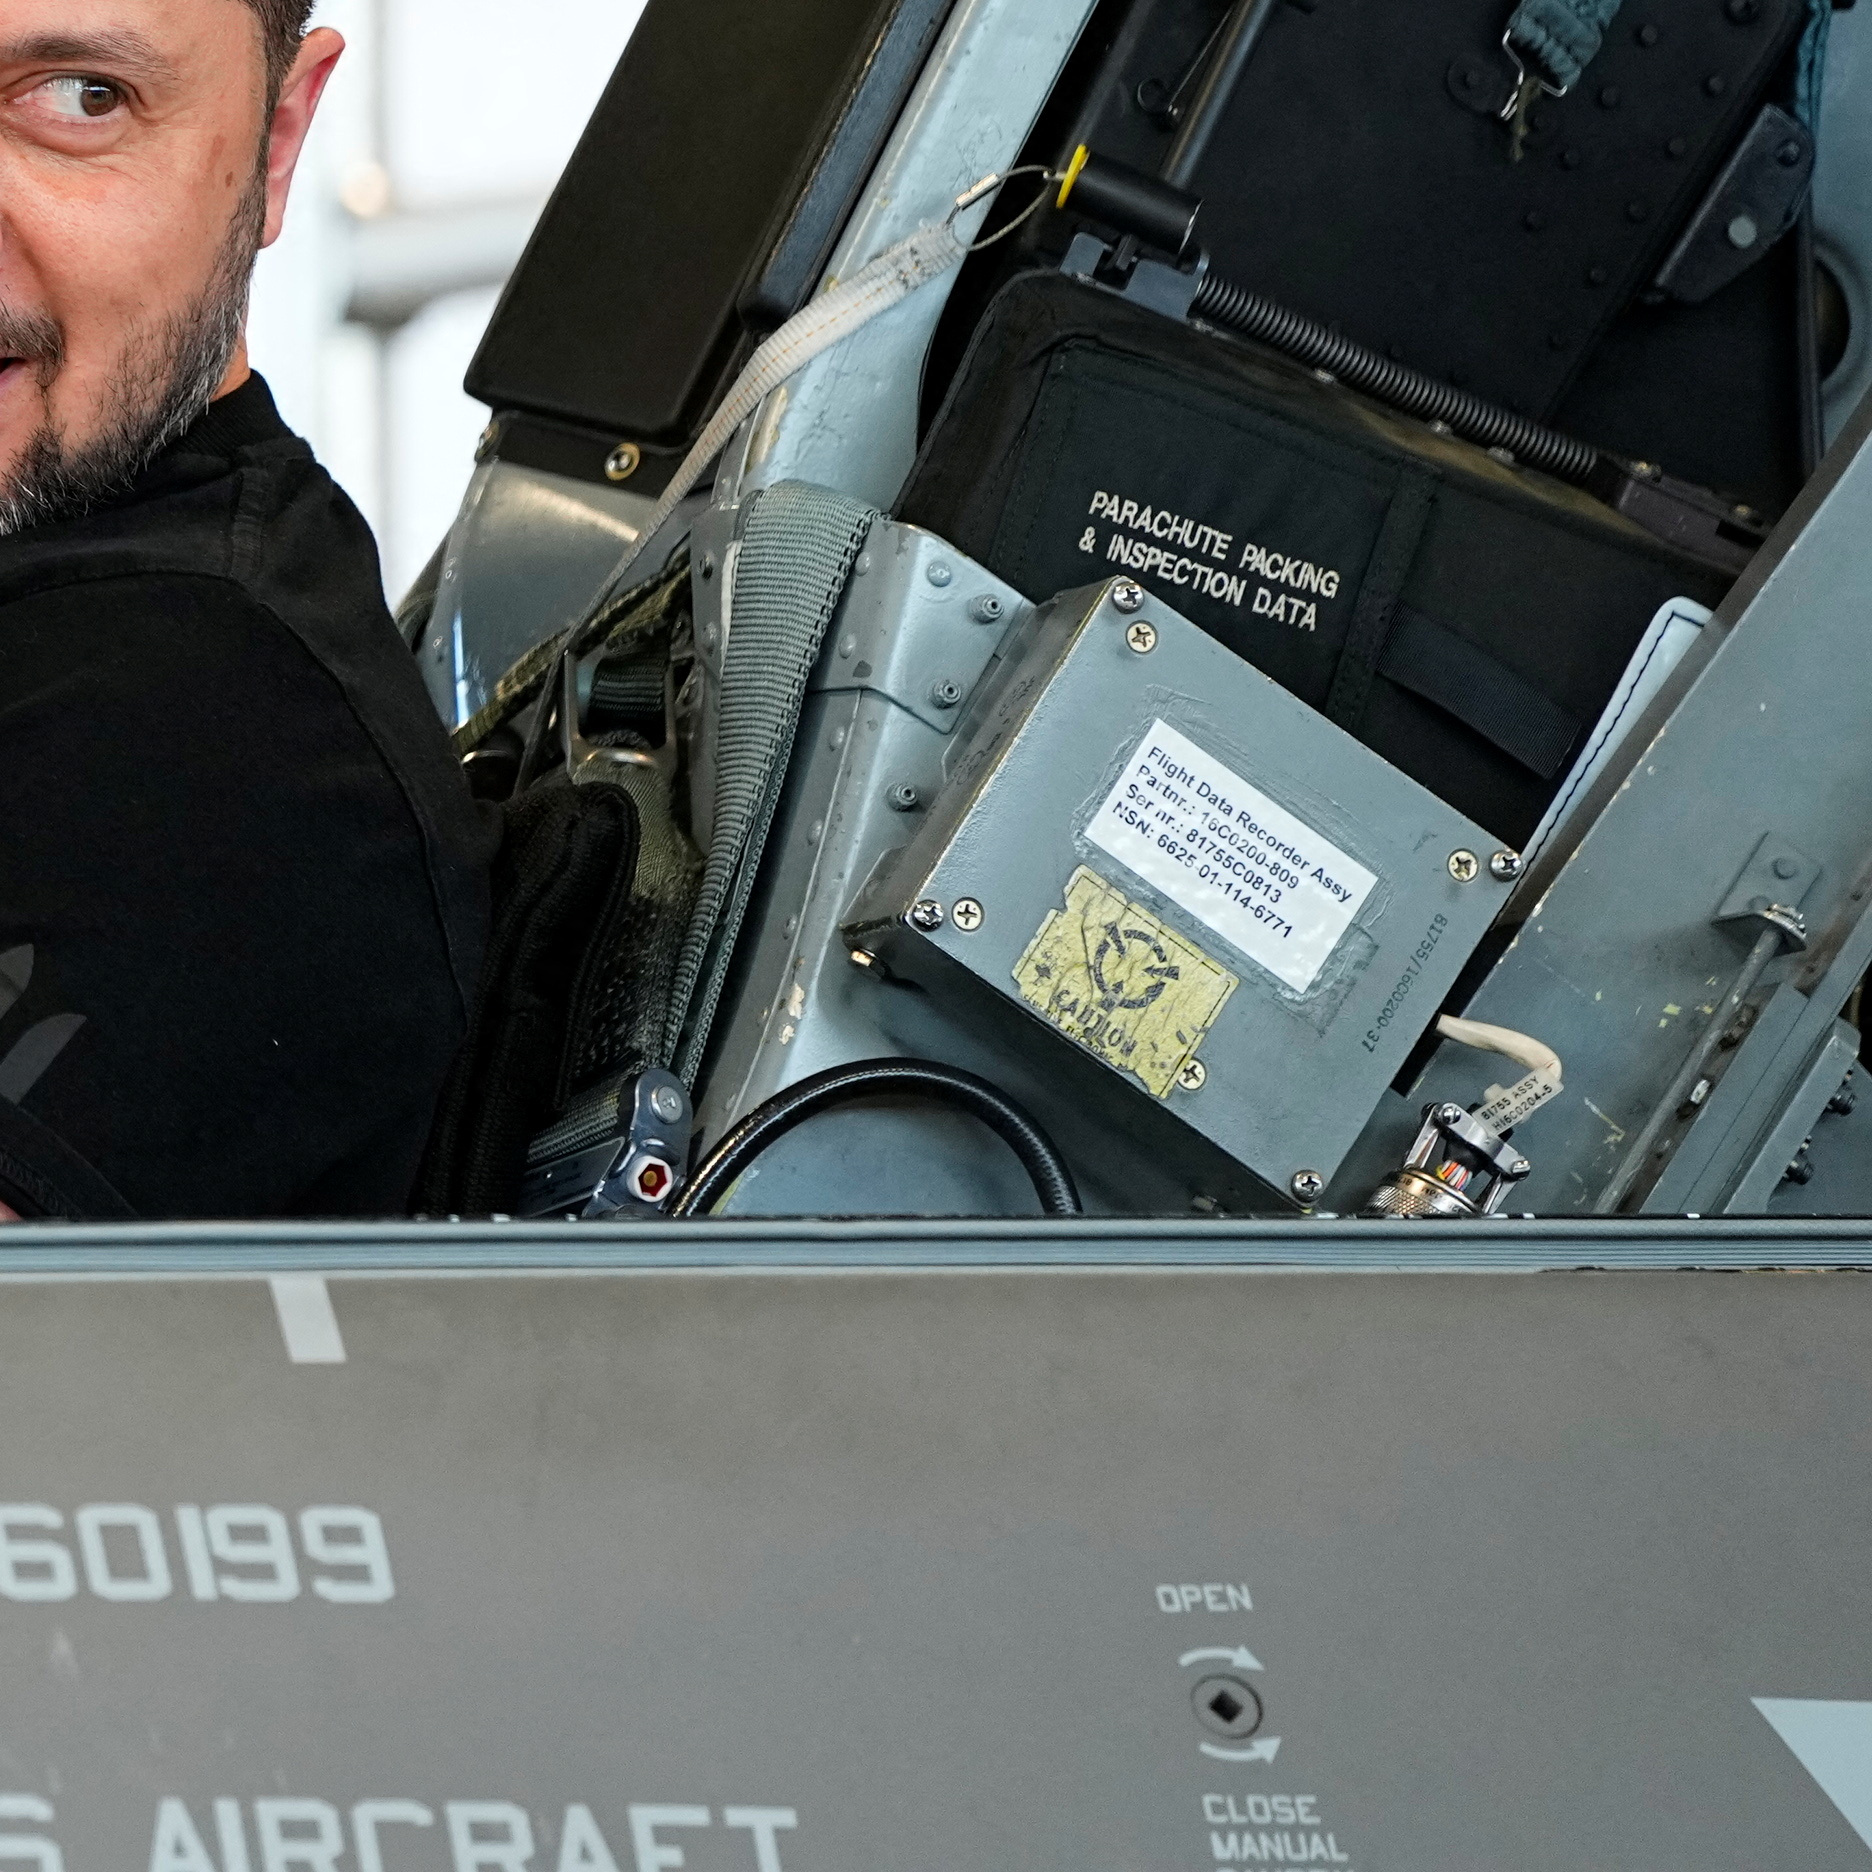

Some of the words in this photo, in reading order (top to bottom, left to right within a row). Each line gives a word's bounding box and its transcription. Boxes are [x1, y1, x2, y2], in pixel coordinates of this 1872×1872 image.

[1078, 526, 1096, 553] &
[1106, 534, 1247, 606] INSPECTION
[1252, 587, 1317, 631] DATA
[1088, 490, 1233, 560] PARACHUTE
[1239, 543, 1341, 598] PACKING
[1126, 784, 1154, 810] Ser
[1186, 828, 1282, 903] 81755C0813
[1148, 746, 1196, 788] Flight
[1196, 781, 1234, 816] Data
[1236, 811, 1310, 870] Recorder
[1310, 867, 1353, 903] Assy
[1201, 812, 1300, 889] 16C0200-809
[1112, 801, 1154, 839] NSN:
[1157, 834, 1293, 938] 6625-01-114-6771
[1481, 1097, 1512, 1120] 81755
[1512, 1076, 1539, 1099] ASSY
[1156, 1583, 1254, 1614] OPEN
[149, 1796, 799, 1872] AIRCRAFT
[1201, 1792, 1322, 1825] CLOSE
[1210, 1830, 1349, 1863] MANUAL
